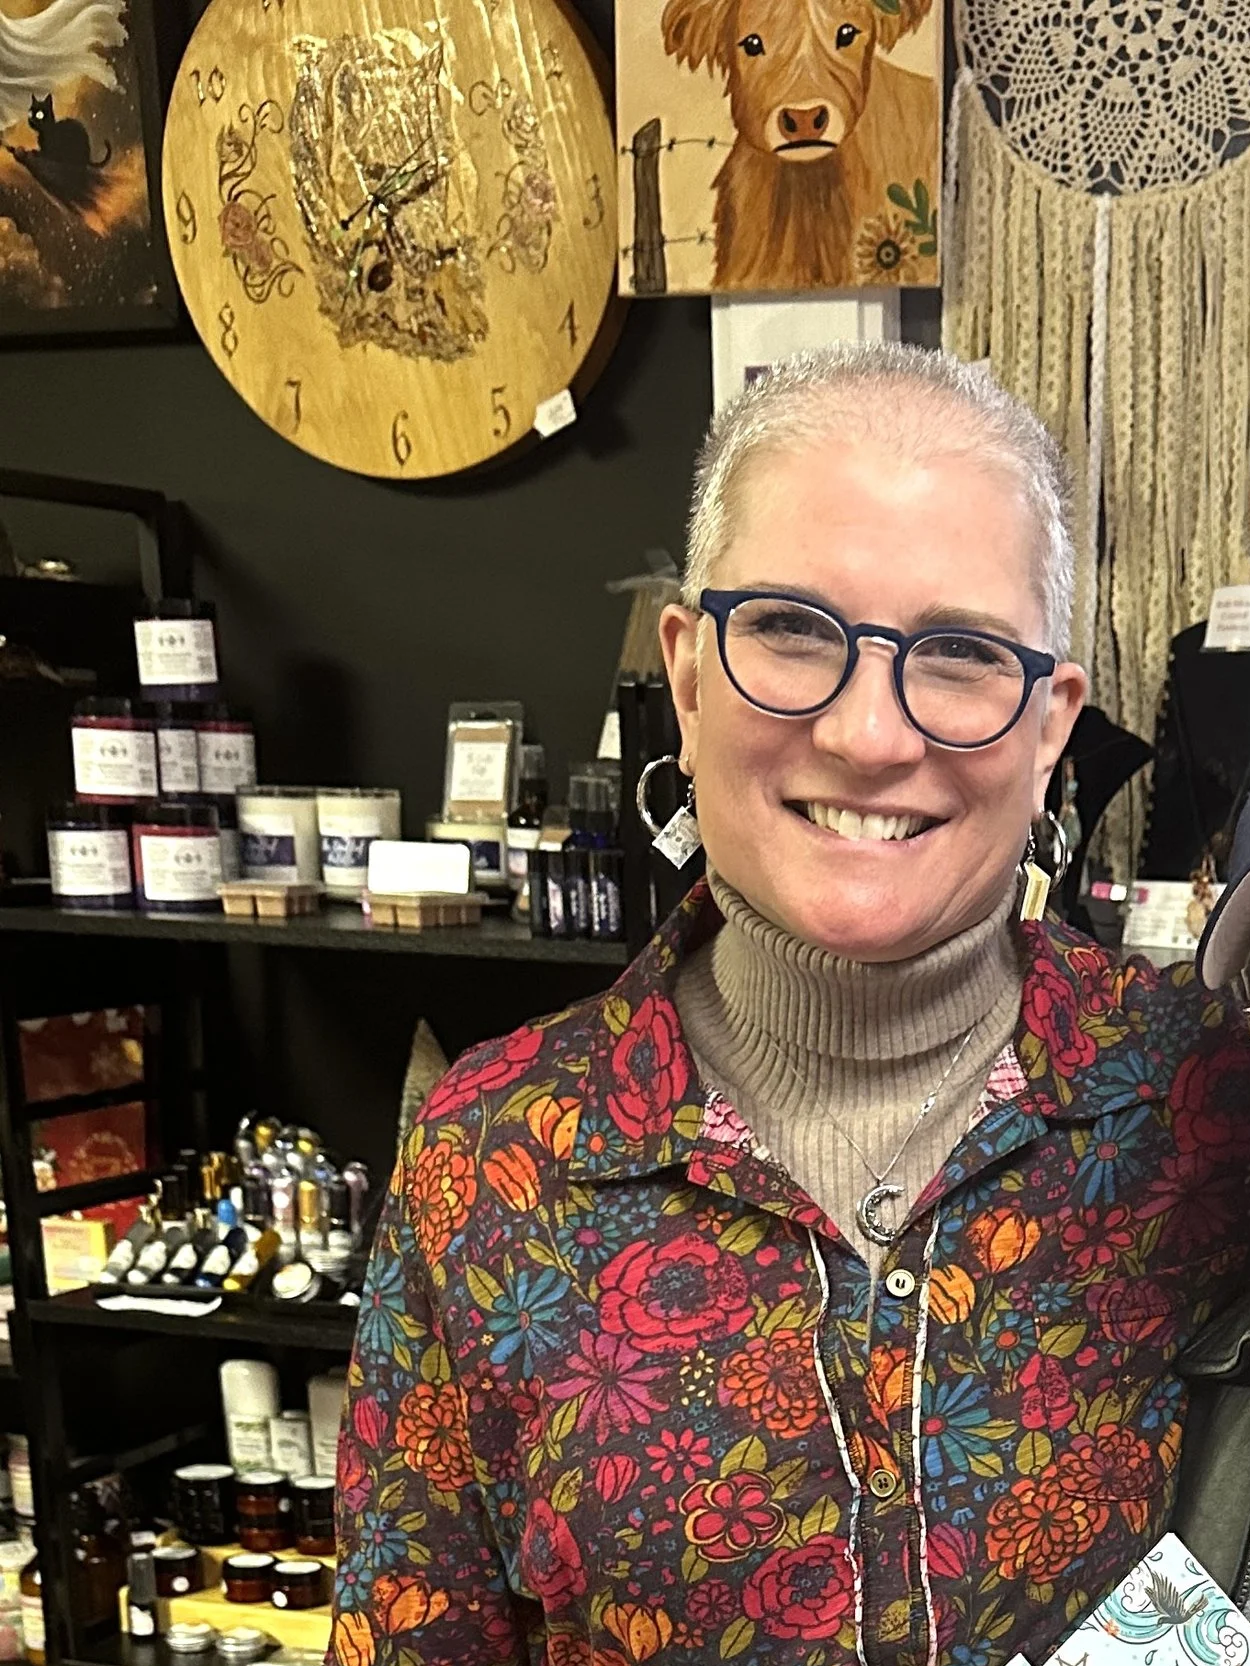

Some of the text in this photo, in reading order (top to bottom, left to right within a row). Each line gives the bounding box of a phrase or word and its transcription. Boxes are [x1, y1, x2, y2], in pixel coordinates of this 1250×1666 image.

[190, 64, 227, 107] 10
[176, 192, 198, 244] 9
[581, 173, 605, 230] 3
[218, 302, 240, 360] 8
[557, 300, 580, 351] 4
[285, 379, 303, 435] 7
[490, 384, 513, 439] 5
[391, 410, 412, 467] 6
